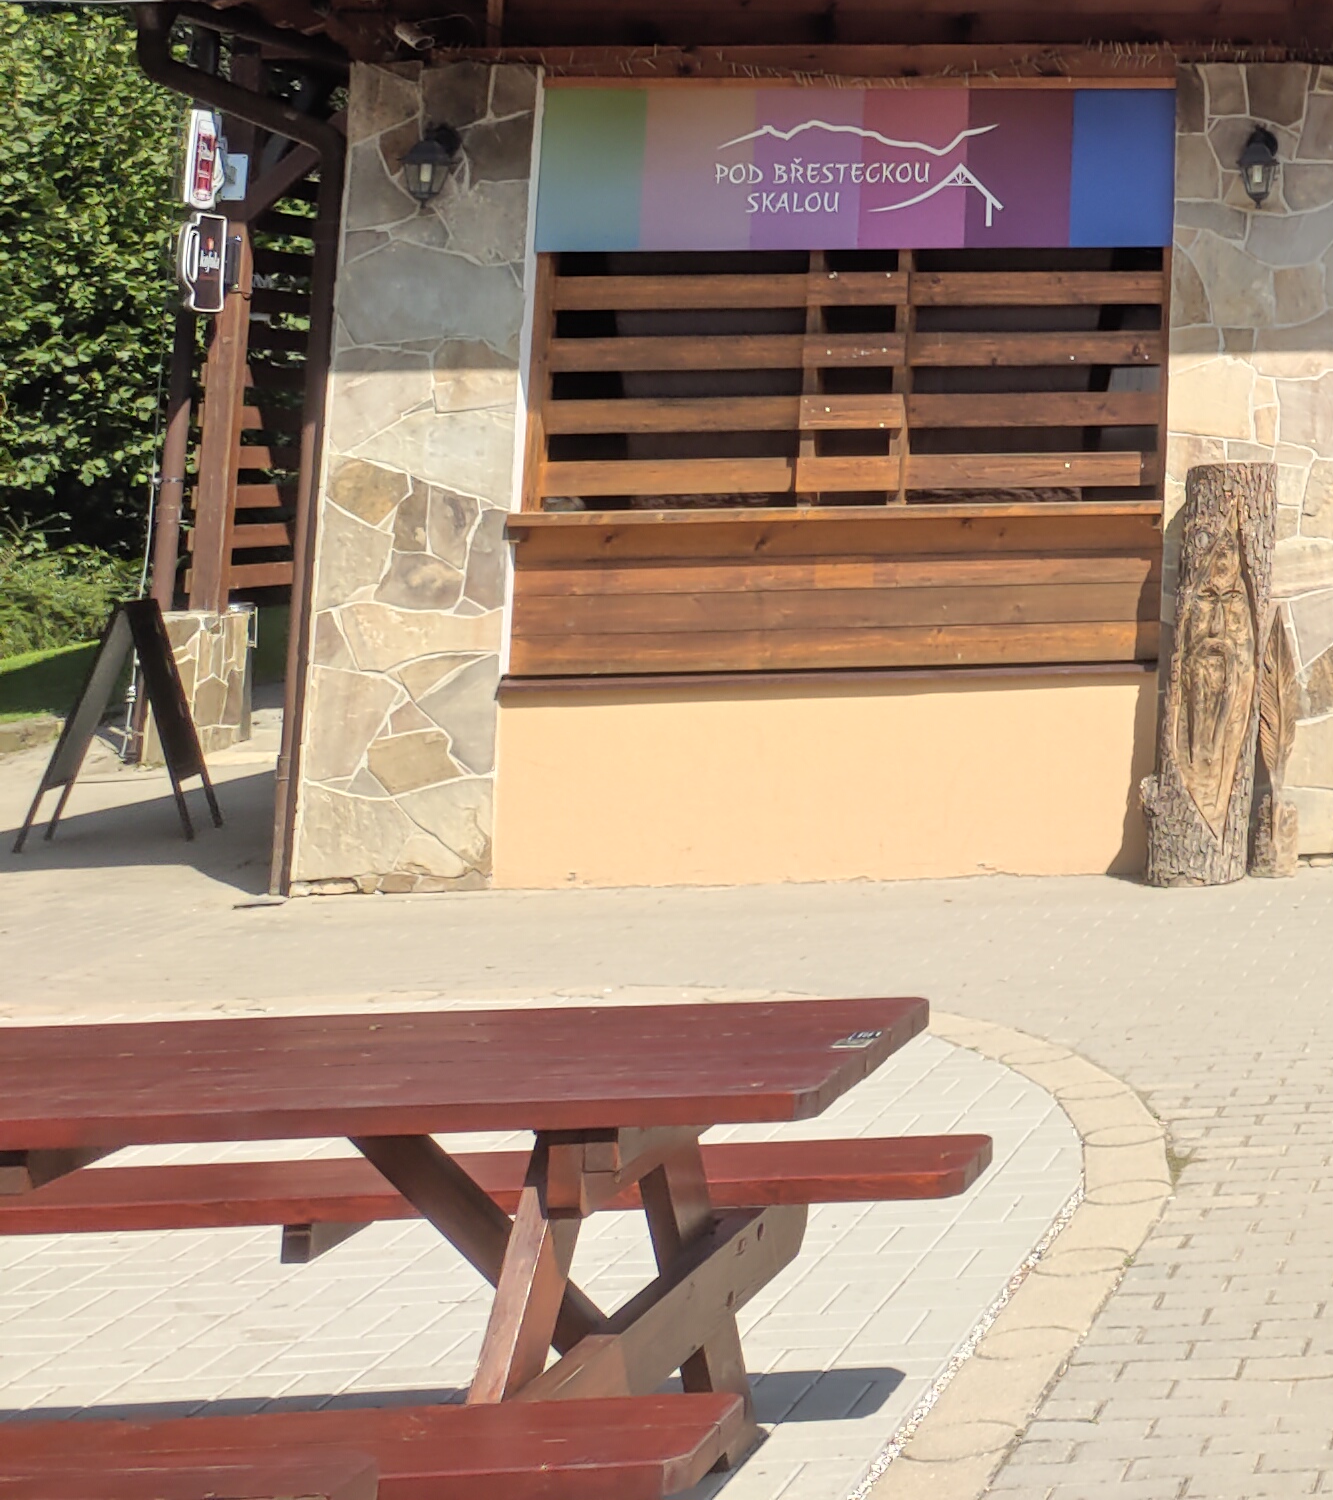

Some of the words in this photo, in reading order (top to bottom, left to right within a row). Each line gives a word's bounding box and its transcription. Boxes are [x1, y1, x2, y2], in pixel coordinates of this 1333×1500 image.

[715, 163, 763, 184] POD
[773, 158, 930, 184] BŘESTECKOU
[746, 192, 840, 213] SKALOU
